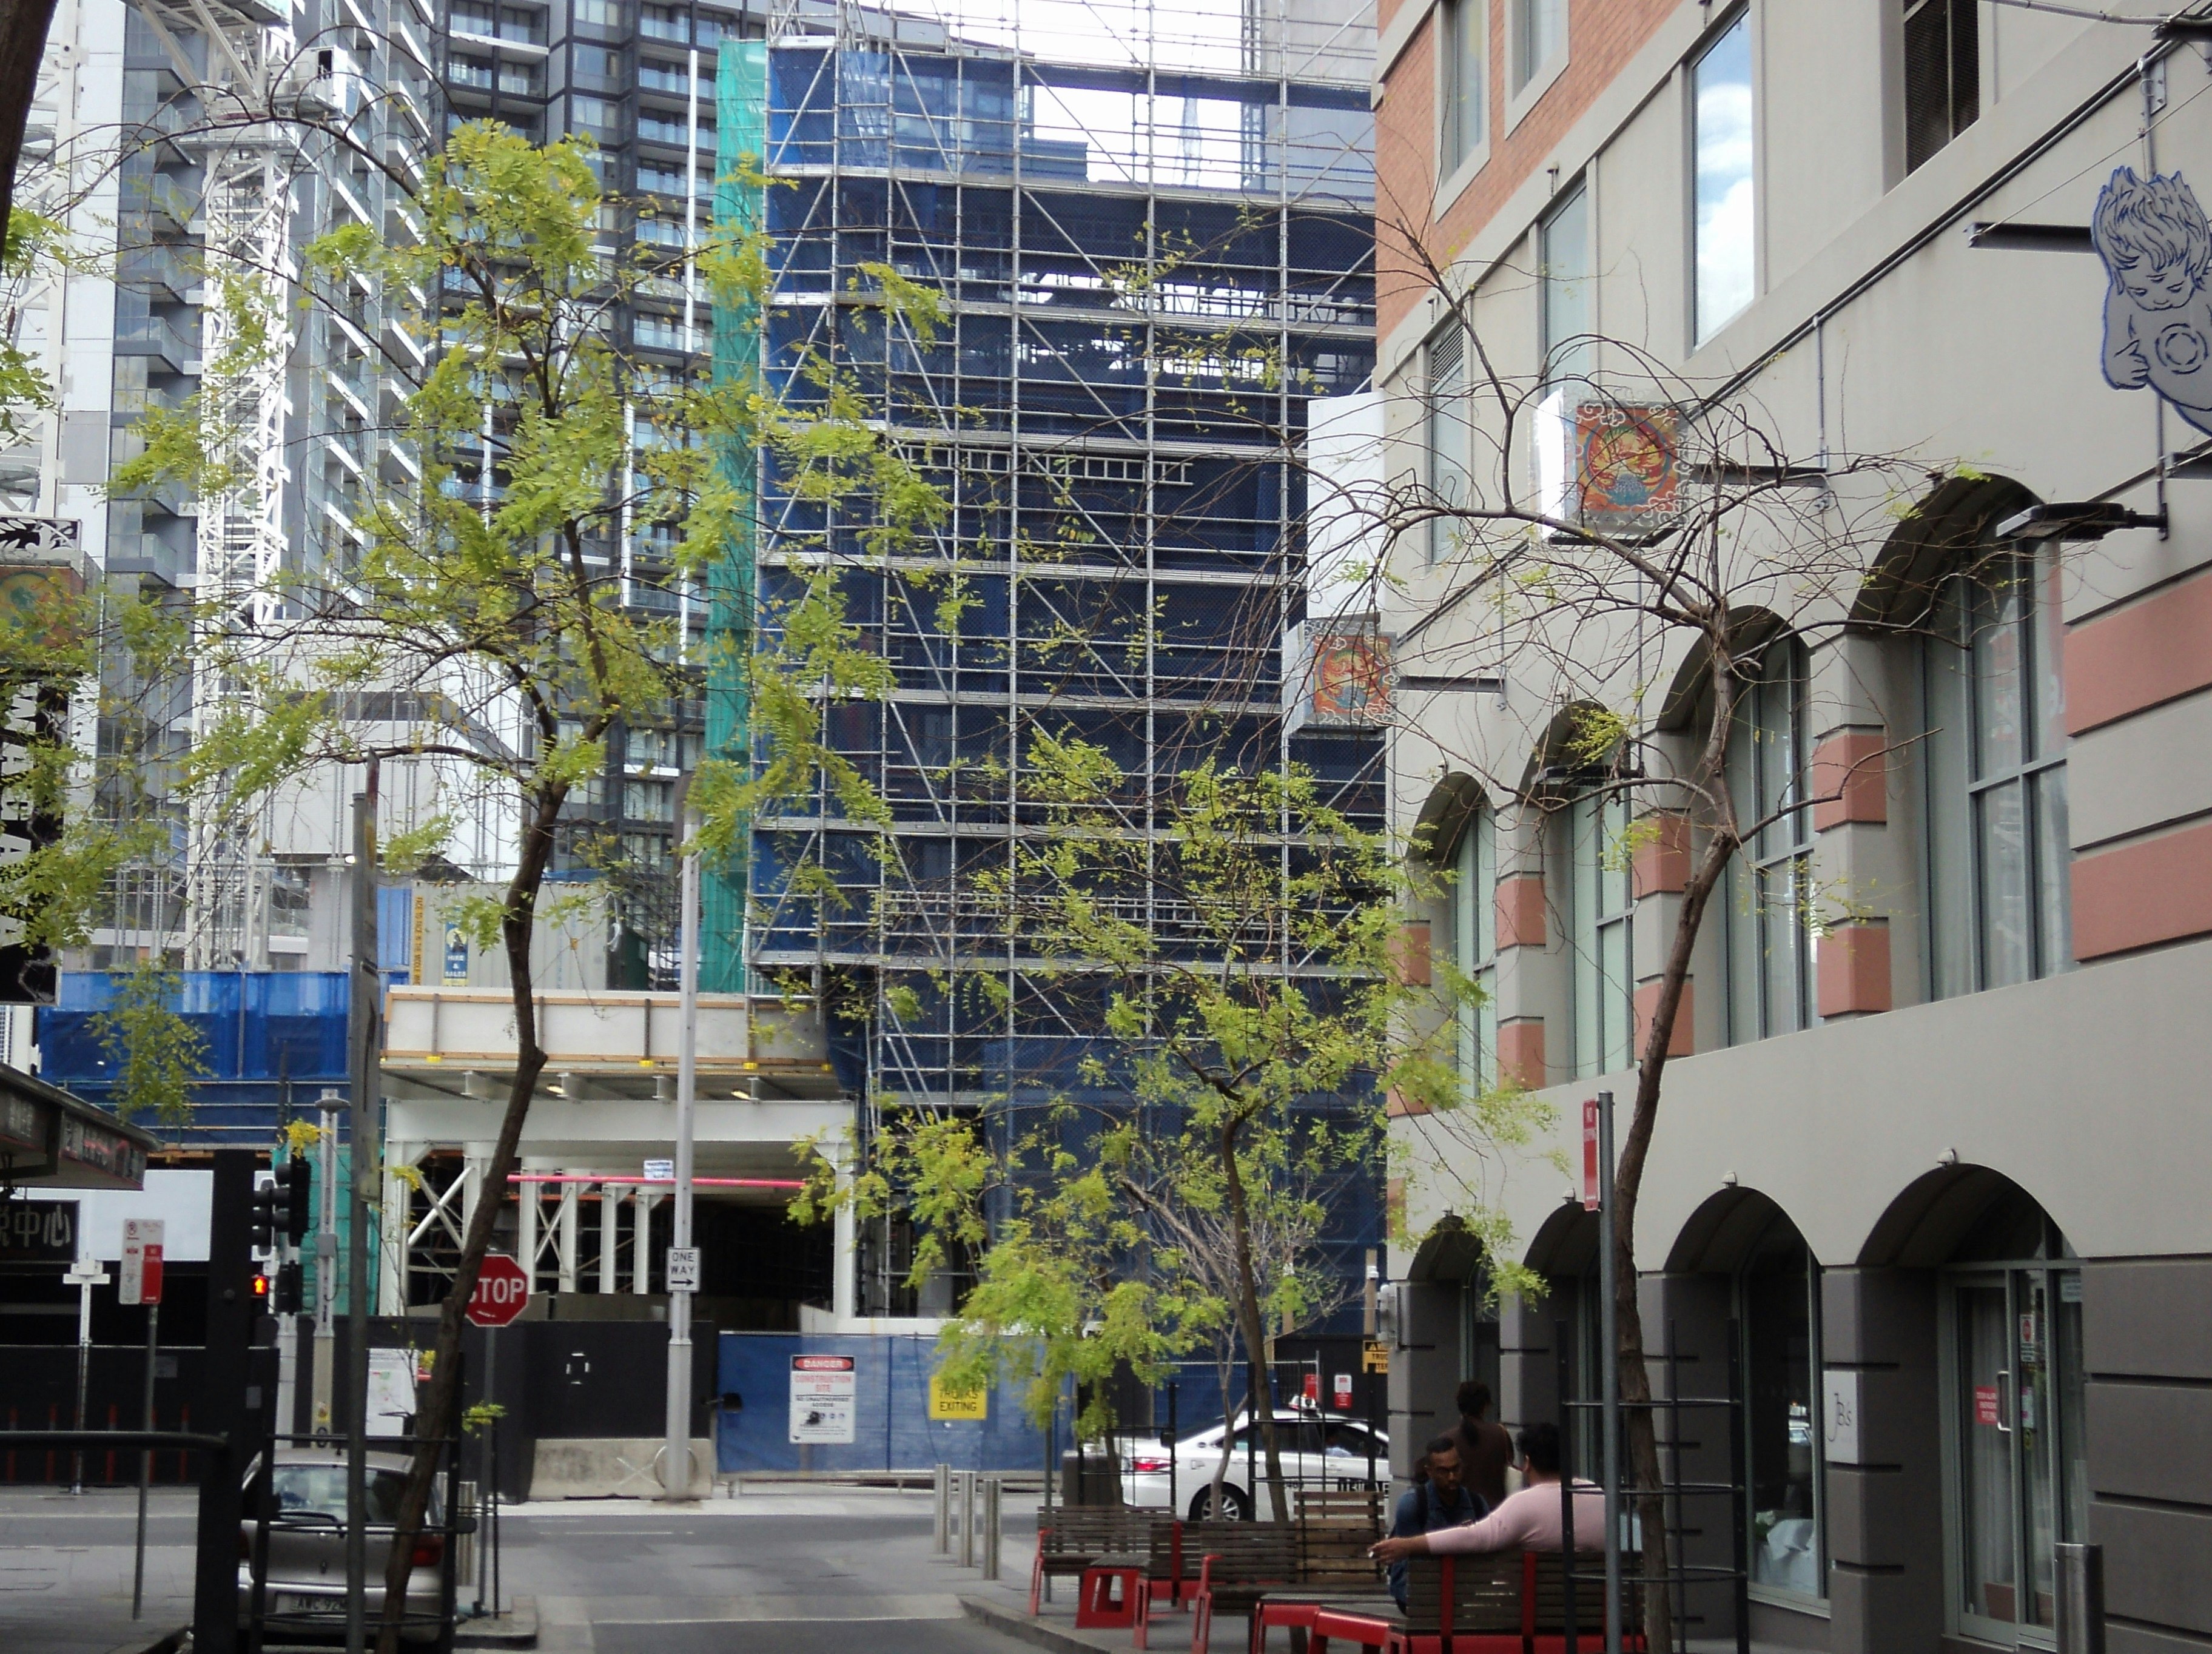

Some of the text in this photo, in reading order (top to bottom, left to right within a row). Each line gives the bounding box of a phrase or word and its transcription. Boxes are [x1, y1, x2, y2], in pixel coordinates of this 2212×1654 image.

[672, 1252, 694, 1262] ONE
[670, 1265, 694, 1274] WAY
[469, 1277, 525, 1303] TOP
[940, 1401, 977, 1412] EXITING
